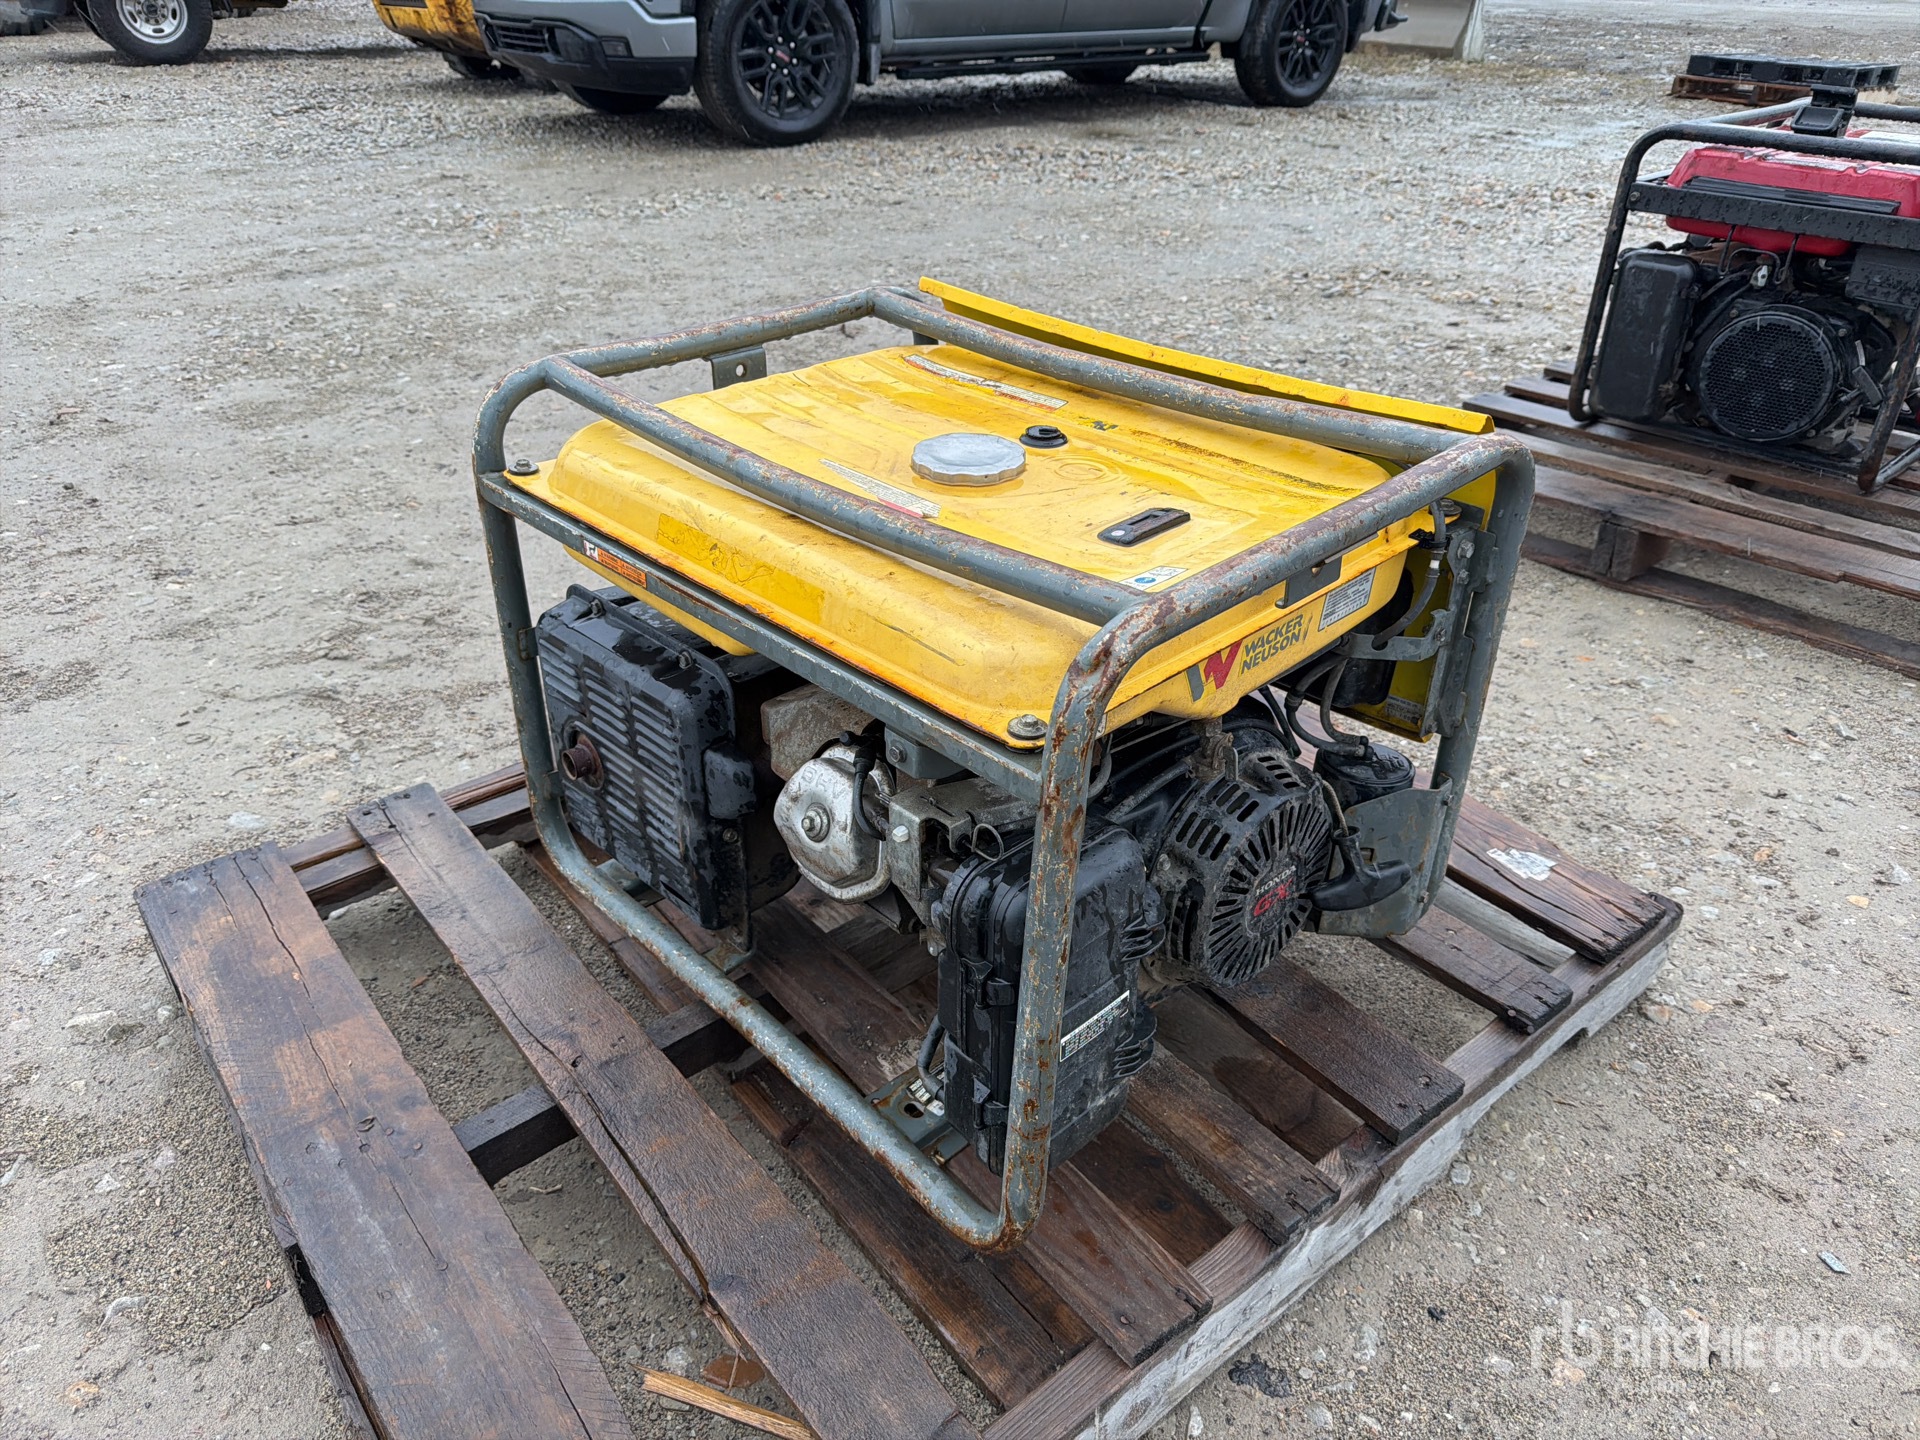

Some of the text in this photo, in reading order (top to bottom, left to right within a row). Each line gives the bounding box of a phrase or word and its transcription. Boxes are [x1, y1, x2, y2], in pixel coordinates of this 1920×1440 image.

[1242, 629, 1301, 673] NEUSON
[1244, 614, 1304, 657] WACKER
[1253, 878, 1293, 917] GX
[1255, 865, 1297, 895] HONDA
